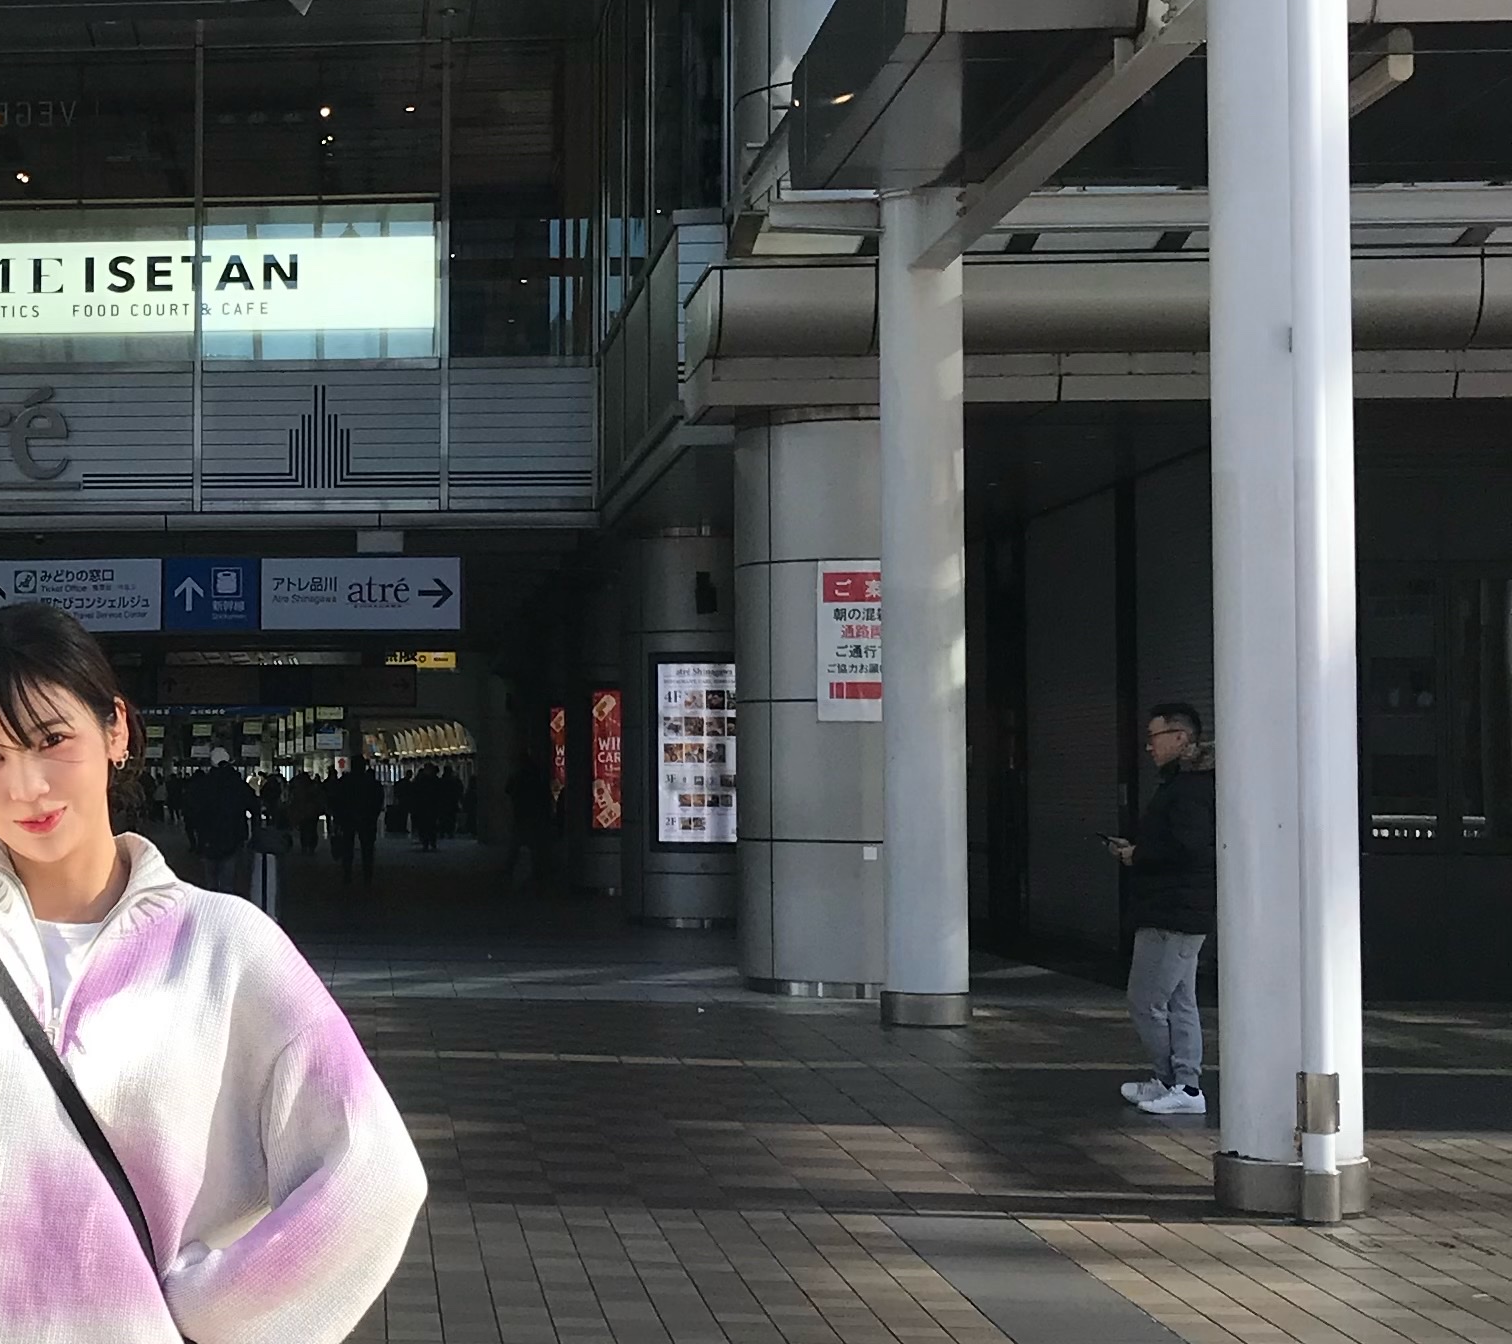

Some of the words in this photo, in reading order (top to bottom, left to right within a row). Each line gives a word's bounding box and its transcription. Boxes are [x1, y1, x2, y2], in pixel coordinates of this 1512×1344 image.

[85, 253, 298, 293] ISETAN
[72, 304, 120, 318] FOOD
[130, 303, 190, 318] COURT
[200, 303, 212, 316] &
[221, 302, 269, 316] CAFE
[40, 569, 115, 583] みどりの窓口
[41, 584, 63, 593] Ticket
[64, 584, 88, 593] Office
[272, 576, 338, 593] アトレ品川
[347, 575, 410, 603] atré
[665, 817, 676, 826] 2F
